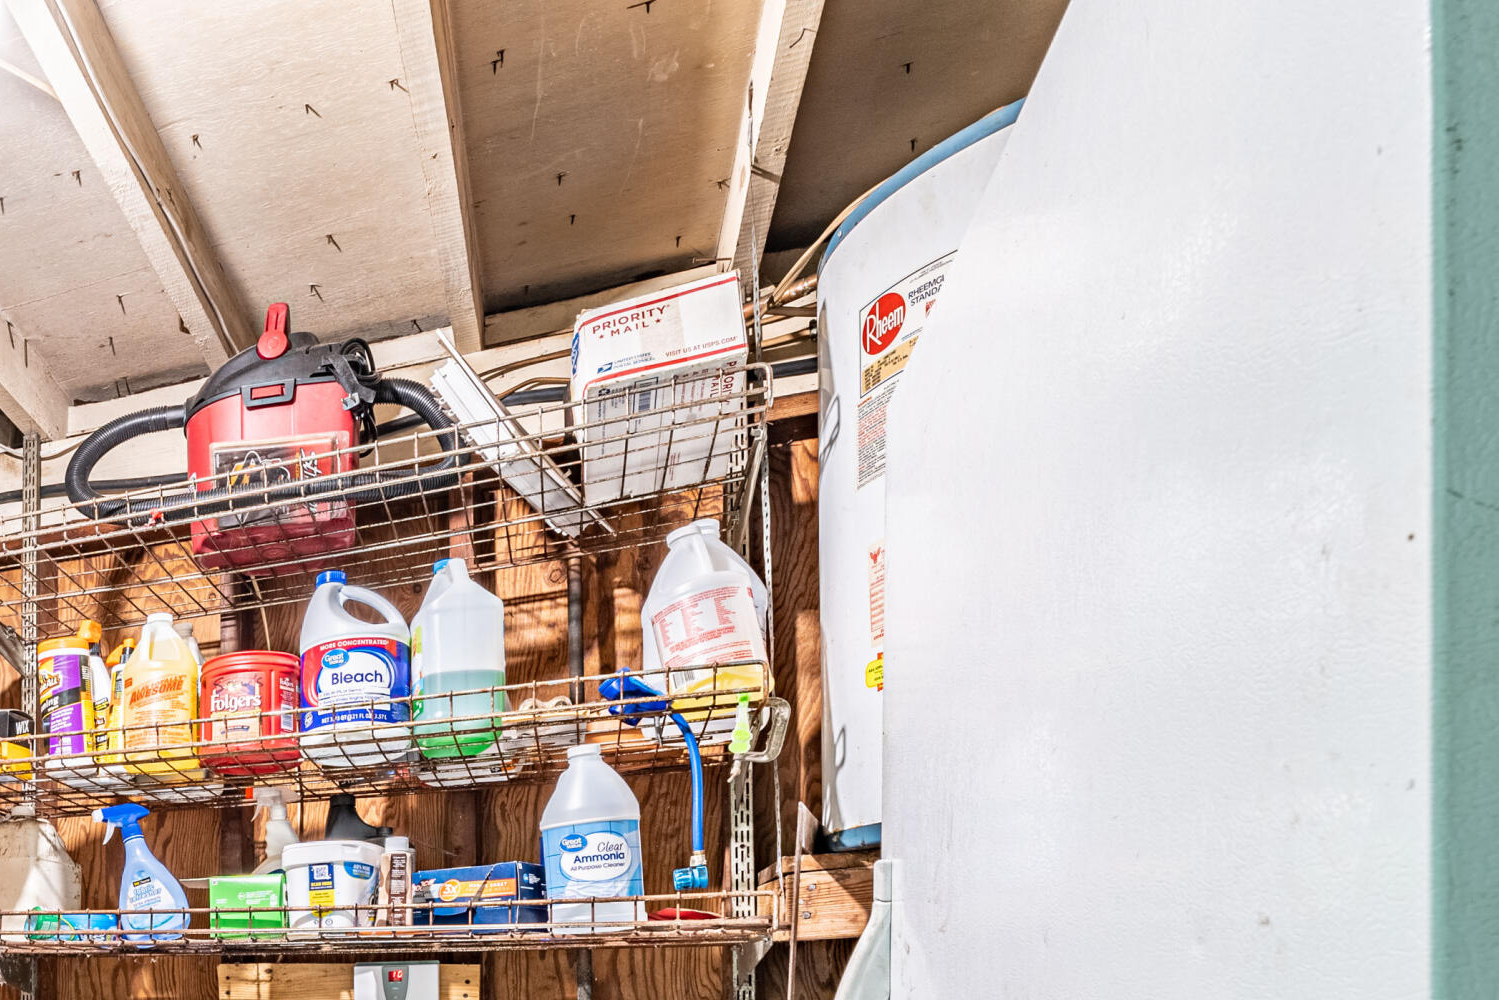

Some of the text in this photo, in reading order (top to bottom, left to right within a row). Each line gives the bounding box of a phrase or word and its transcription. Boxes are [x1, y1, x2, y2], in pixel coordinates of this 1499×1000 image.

[592, 305, 666, 335] PRIORITY
[866, 301, 904, 353] Rheem
[610, 321, 650, 337] MAIL
[665, 349, 681, 357] VISIT
[320, 639, 388, 652] MORE CONCENTRATED
[331, 670, 383, 686] Bleach
[211, 688, 262, 713] Folgers
[15, 720, 29, 734] WIX
[597, 841, 624, 853] Clear
[573, 852, 625, 864] Ammonia
[443, 883, 458, 894] 3X
